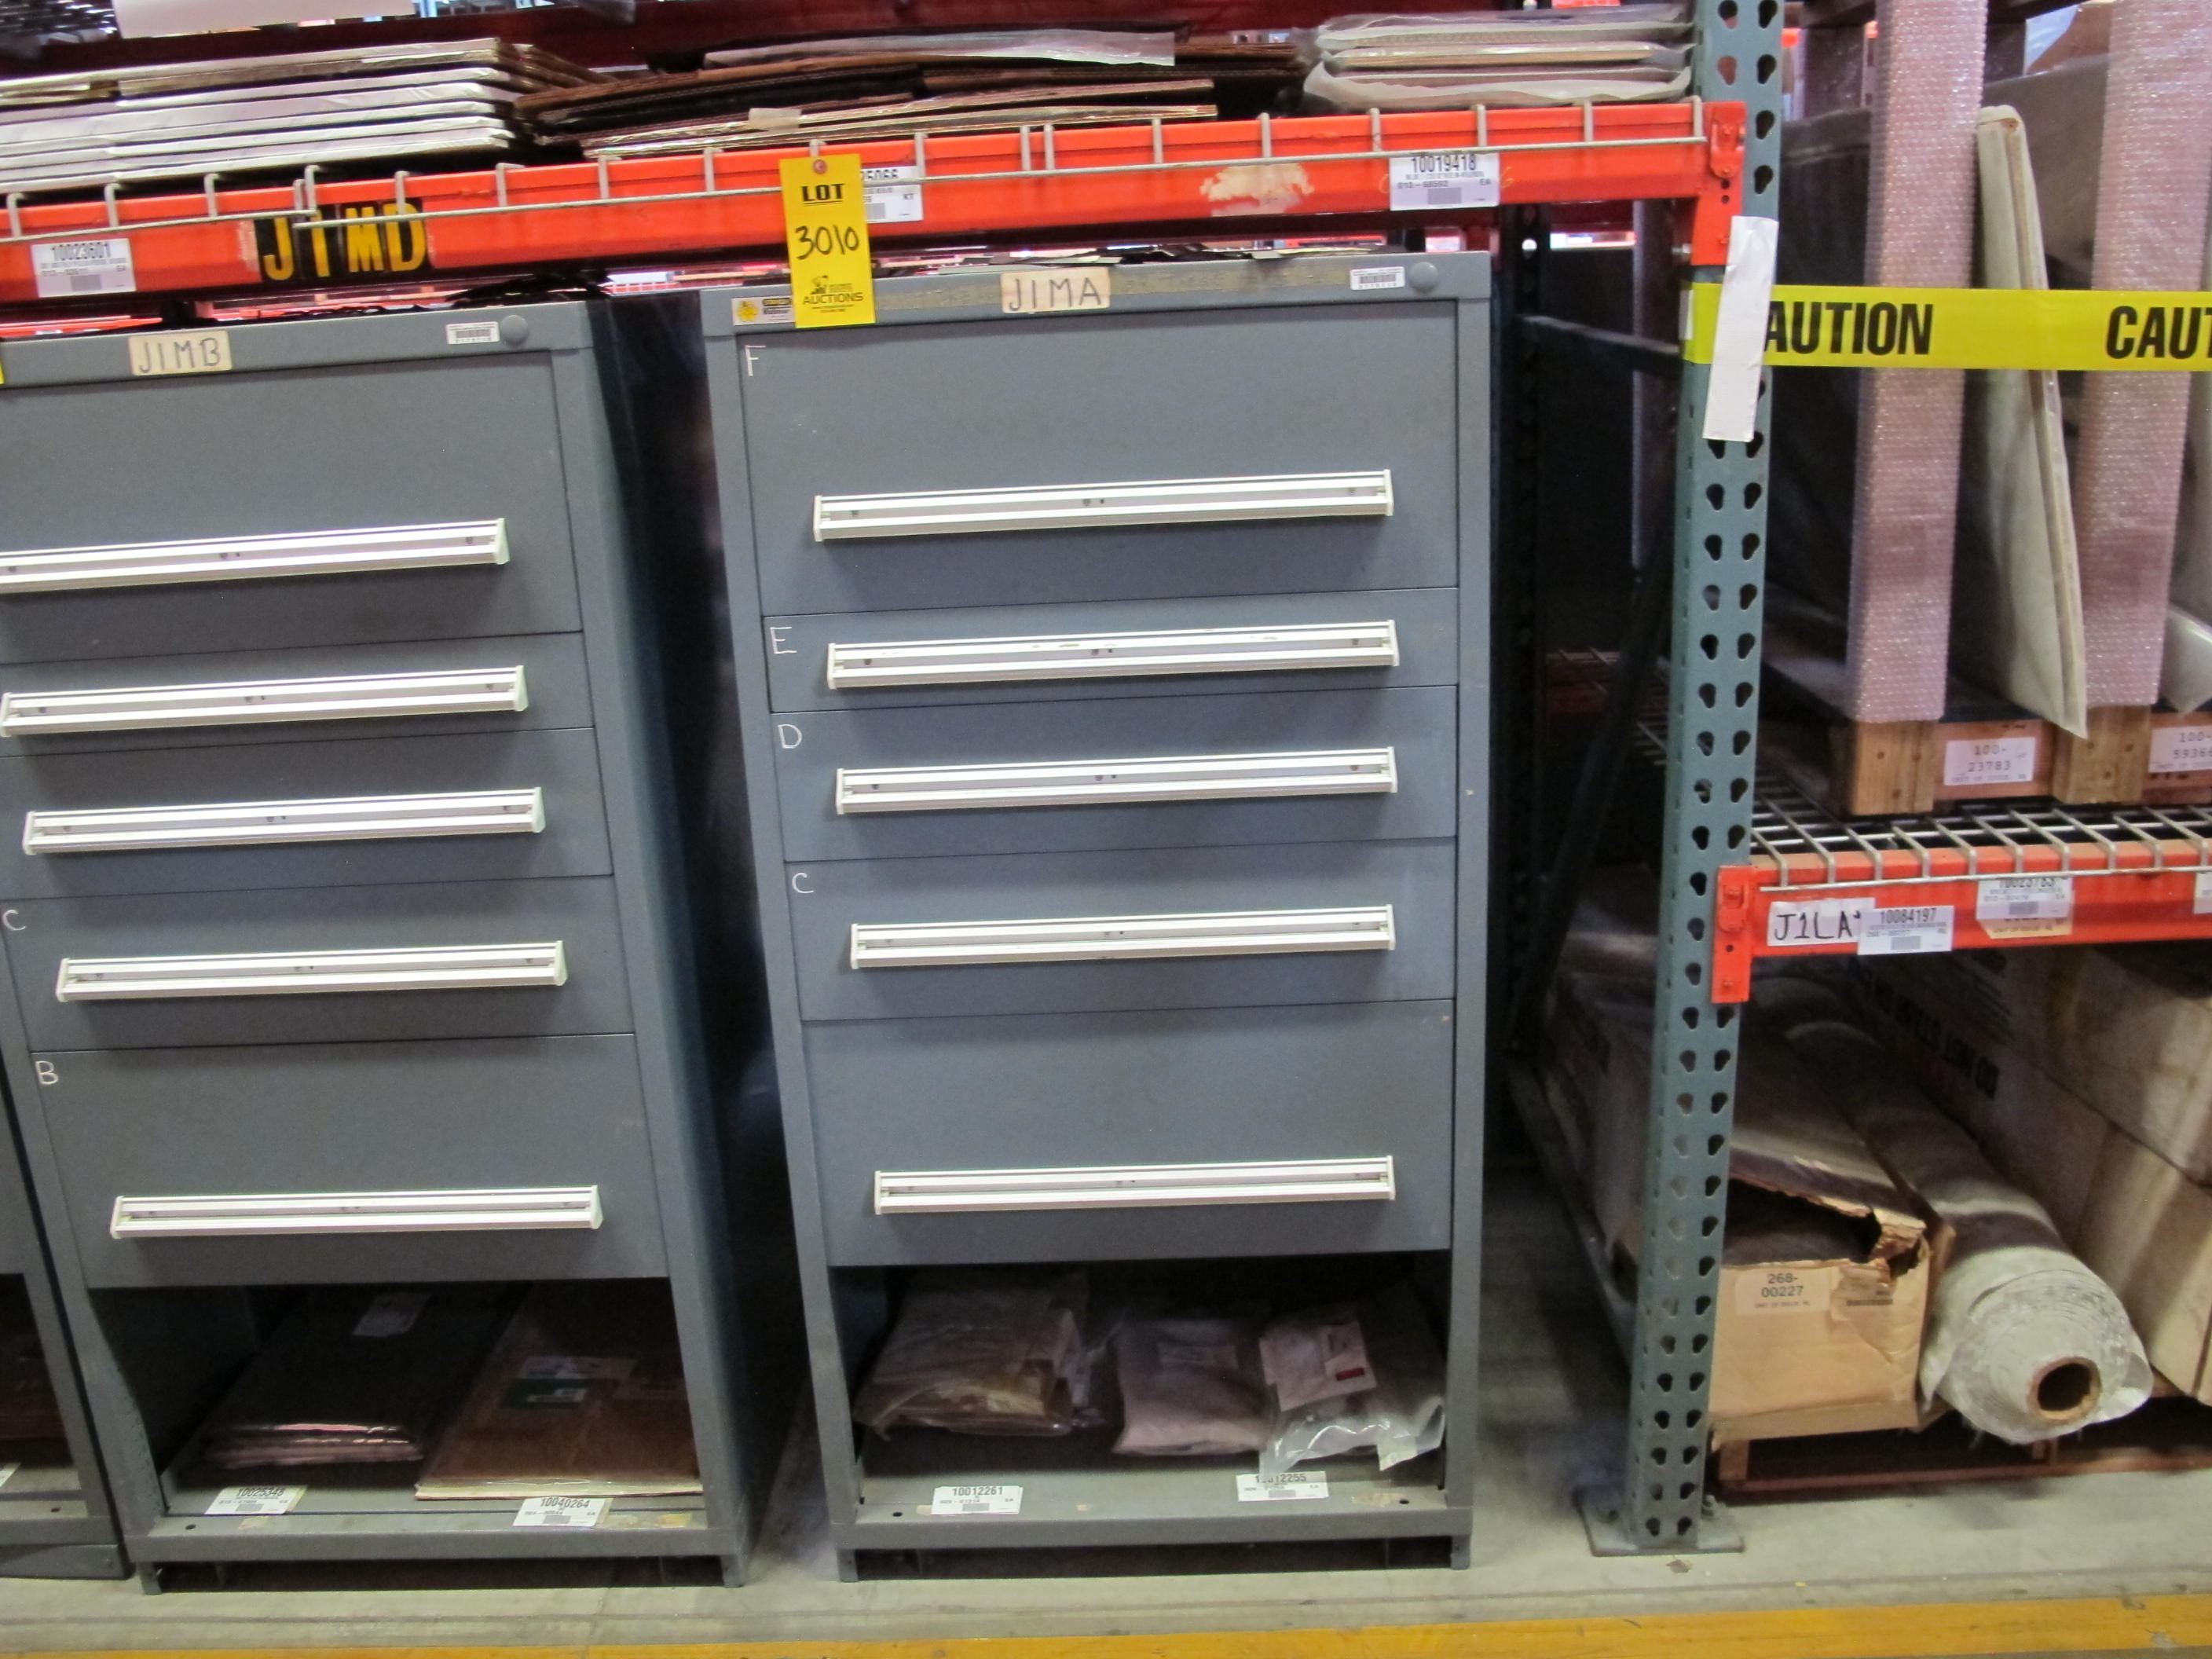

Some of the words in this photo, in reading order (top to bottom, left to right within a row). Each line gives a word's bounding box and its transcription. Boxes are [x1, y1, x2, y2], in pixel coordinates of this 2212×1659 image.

[1411, 153, 1476, 172] 10019418
[801, 183, 844, 202] LOT
[796, 225, 859, 260] 3010
[802, 291, 864, 305] AUCTIONS
[1764, 301, 1934, 356] AUTION
[2107, 306, 2212, 359] CAU
[745, 345, 767, 376] F
[770, 627, 797, 654] E
[778, 723, 803, 749] D
[792, 872, 815, 894] C
[2, 909, 26, 931] C
[35, 1060, 59, 1085] B
[1768, 1273, 1798, 1284] 268-
[1760, 1285, 1804, 1298] 00227
[540, 1496, 591, 1508] 10040264
[954, 1486, 1003, 1496] 10012261
